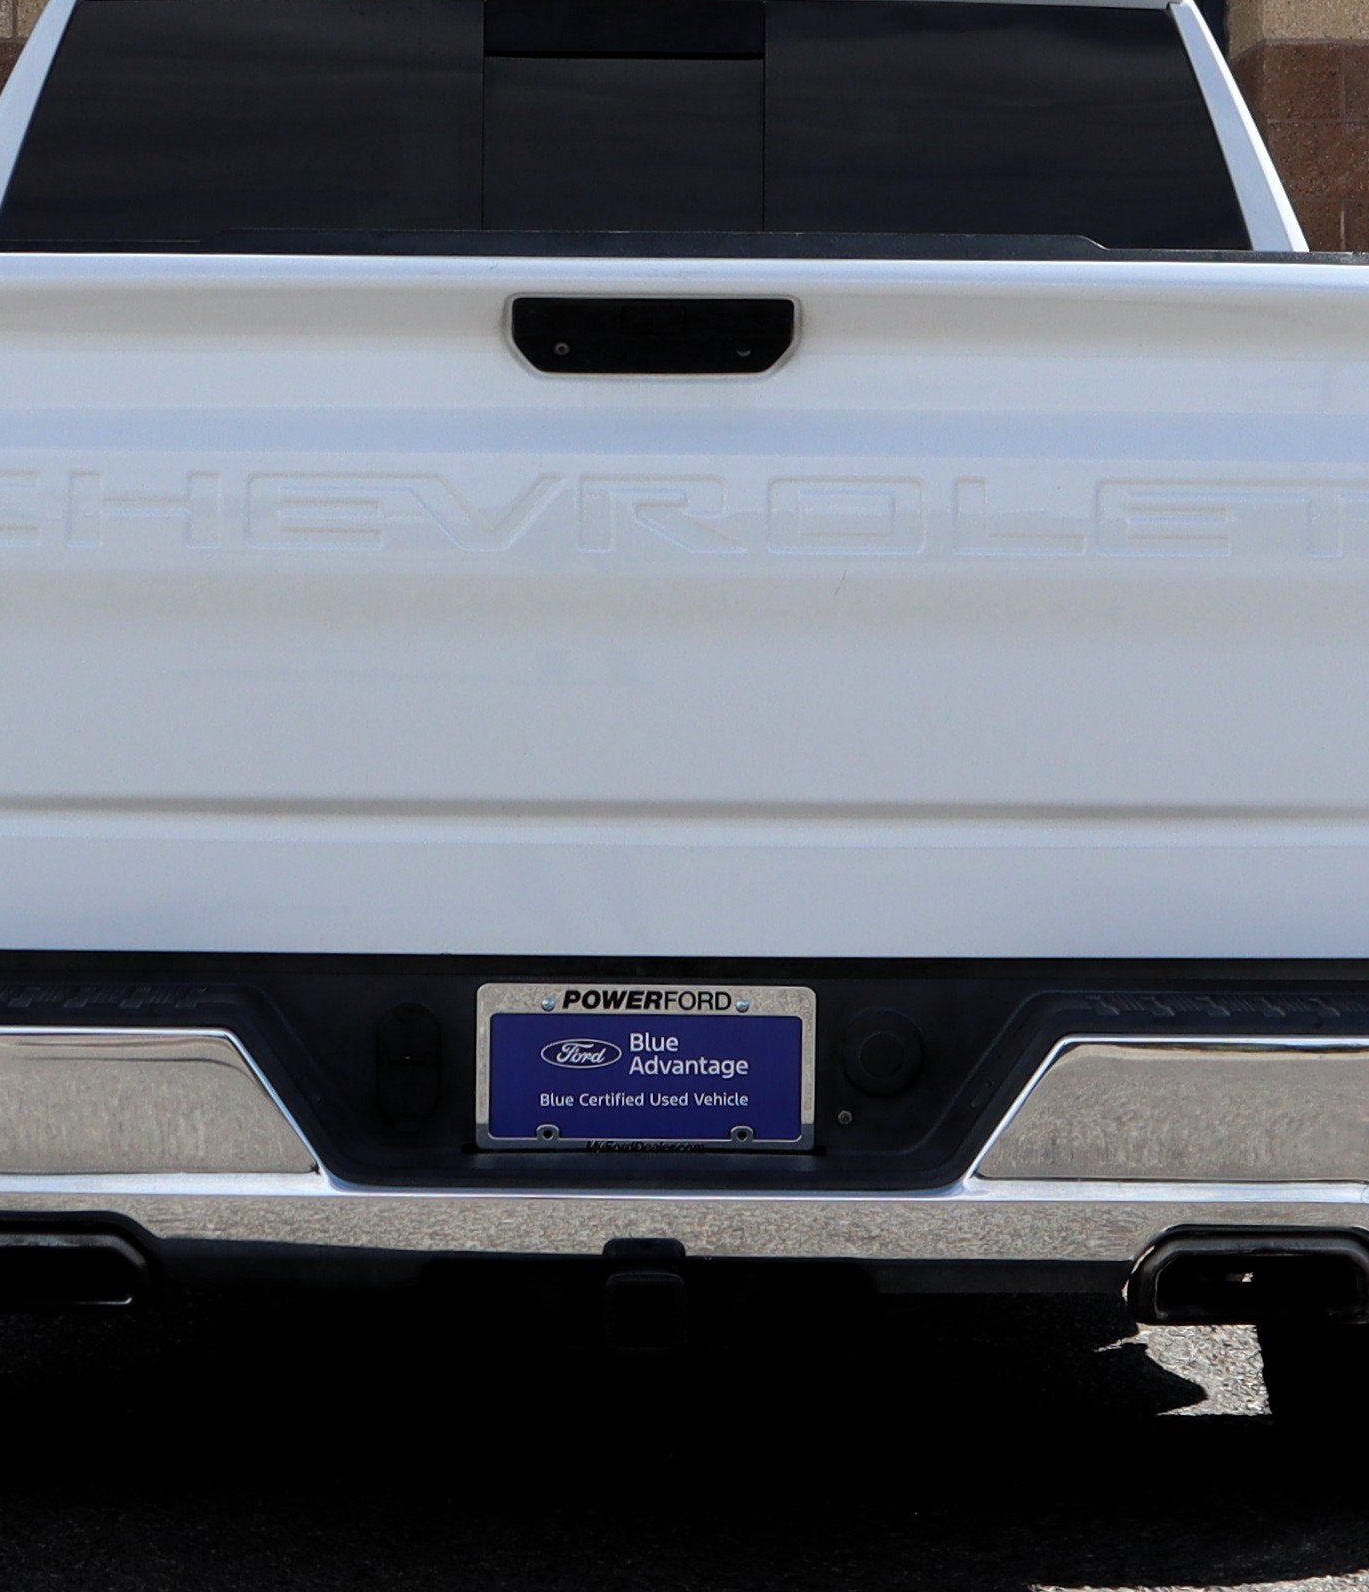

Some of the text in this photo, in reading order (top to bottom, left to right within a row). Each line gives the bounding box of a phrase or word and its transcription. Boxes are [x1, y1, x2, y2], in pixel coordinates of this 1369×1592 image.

[562, 990, 732, 1011] POWERFORD
[629, 1032, 679, 1053] Blue
[556, 1042, 607, 1065] Ford
[629, 1056, 749, 1079] Advantage
[540, 1092, 749, 1107] Blue Certified Used Vehicle
